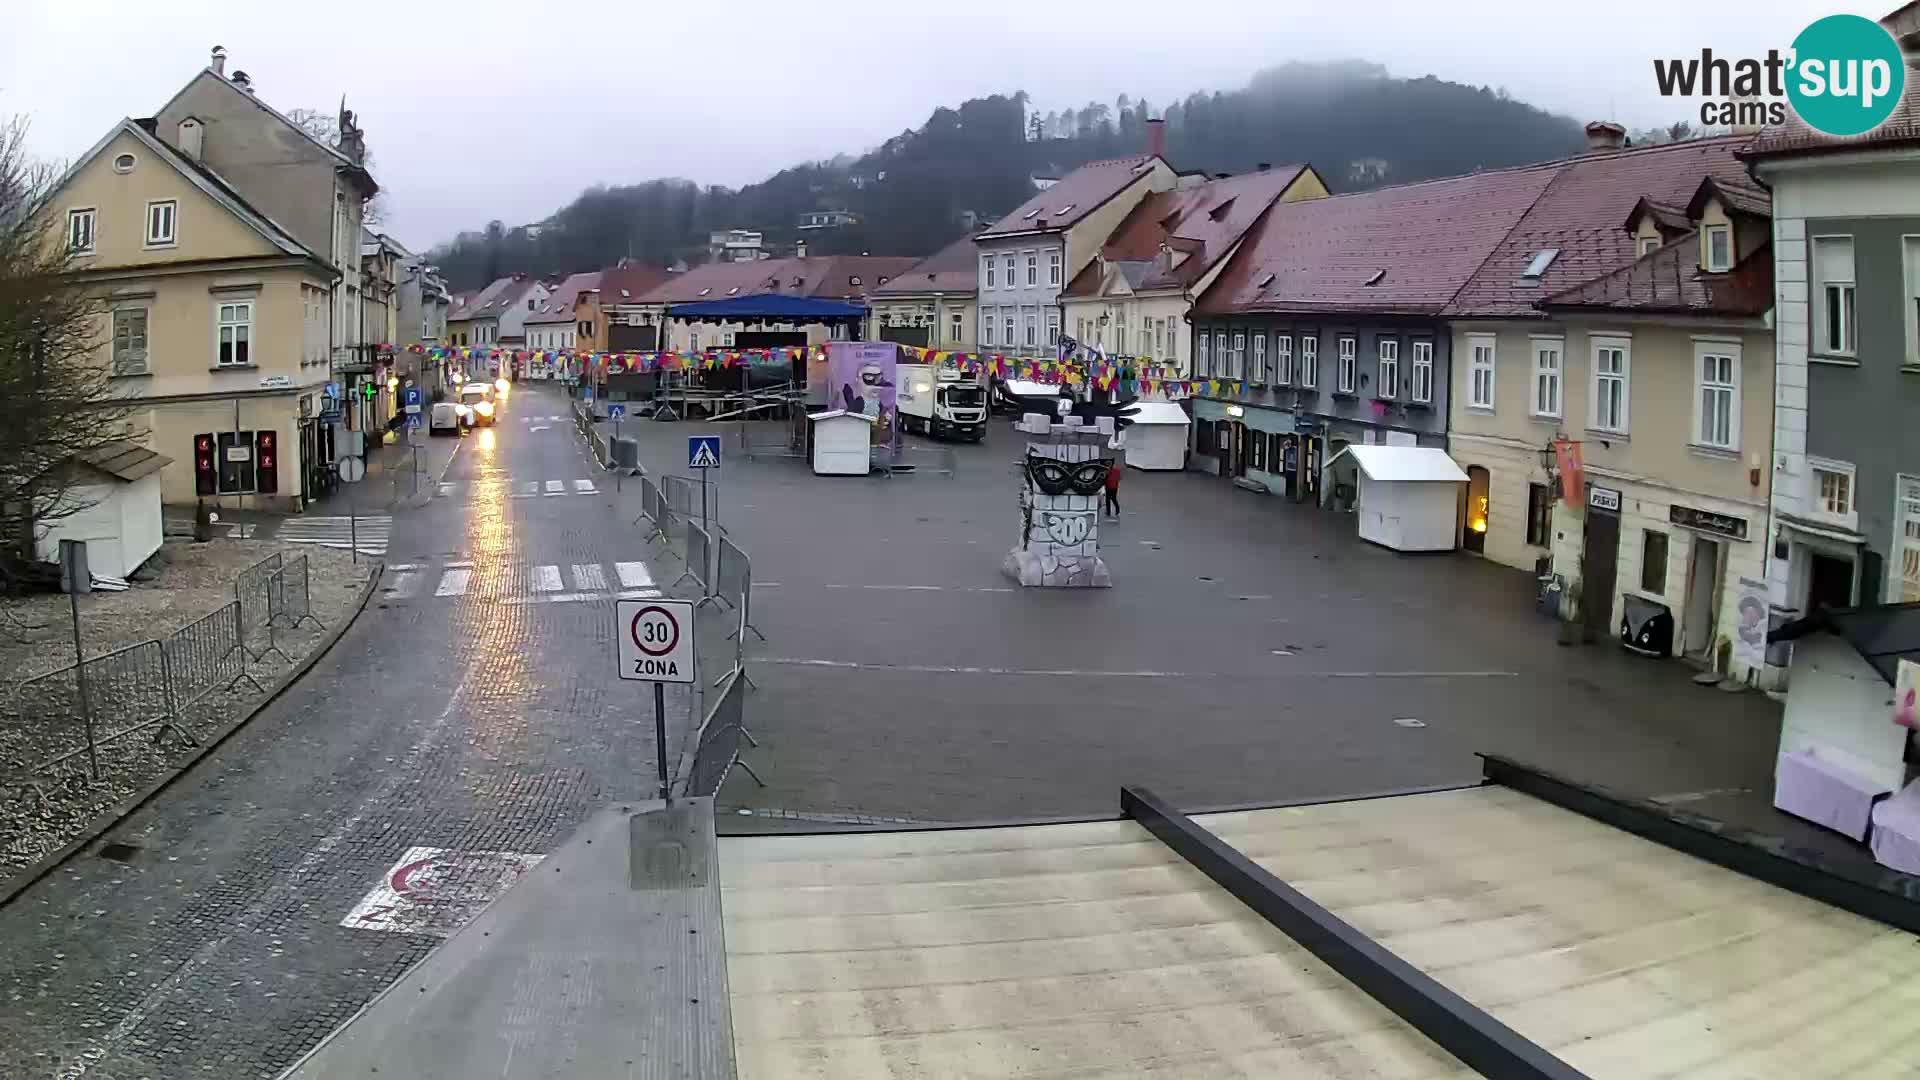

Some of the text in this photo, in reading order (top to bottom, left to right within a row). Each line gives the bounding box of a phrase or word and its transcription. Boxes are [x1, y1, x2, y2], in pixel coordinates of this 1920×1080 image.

[409, 392, 417, 402] P
[1048, 516, 1087, 545] 200
[644, 622, 668, 643] 30
[634, 659, 679, 676] ZONA
